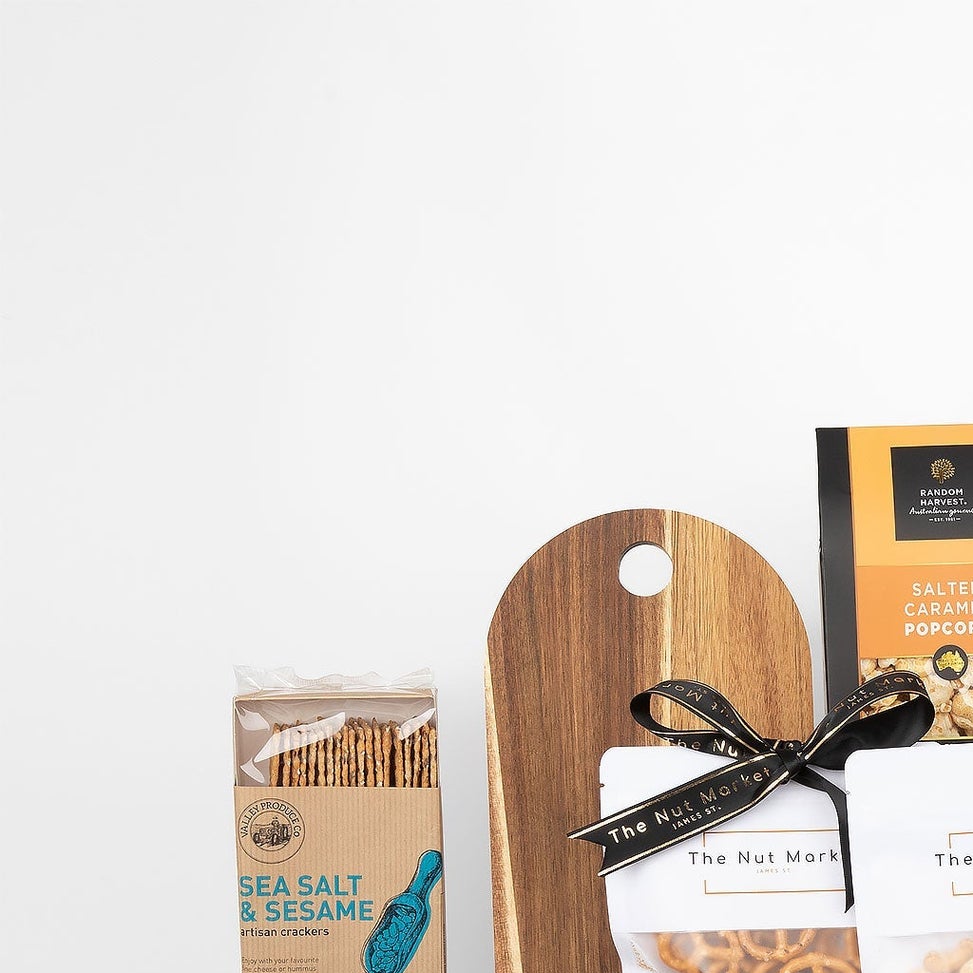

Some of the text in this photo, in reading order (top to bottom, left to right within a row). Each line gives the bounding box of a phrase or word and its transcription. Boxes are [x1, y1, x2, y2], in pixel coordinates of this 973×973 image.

[920, 488, 964, 496] RANDOM
[909, 507, 948, 515] Australian
[607, 766, 771, 845] The Nut Market
[240, 802, 302, 838] VALLEY PRODUCE CO
[672, 804, 722, 830] JAMES ST.
[688, 849, 840, 865] The Nut Mark
[934, 853, 973, 867] The
[240, 874, 363, 897] SEA SALT
[241, 900, 374, 922] & SESAME
[240, 926, 330, 937] artisan crackers
[274, 958, 289, 966] your
[290, 956, 320, 964] favourite
